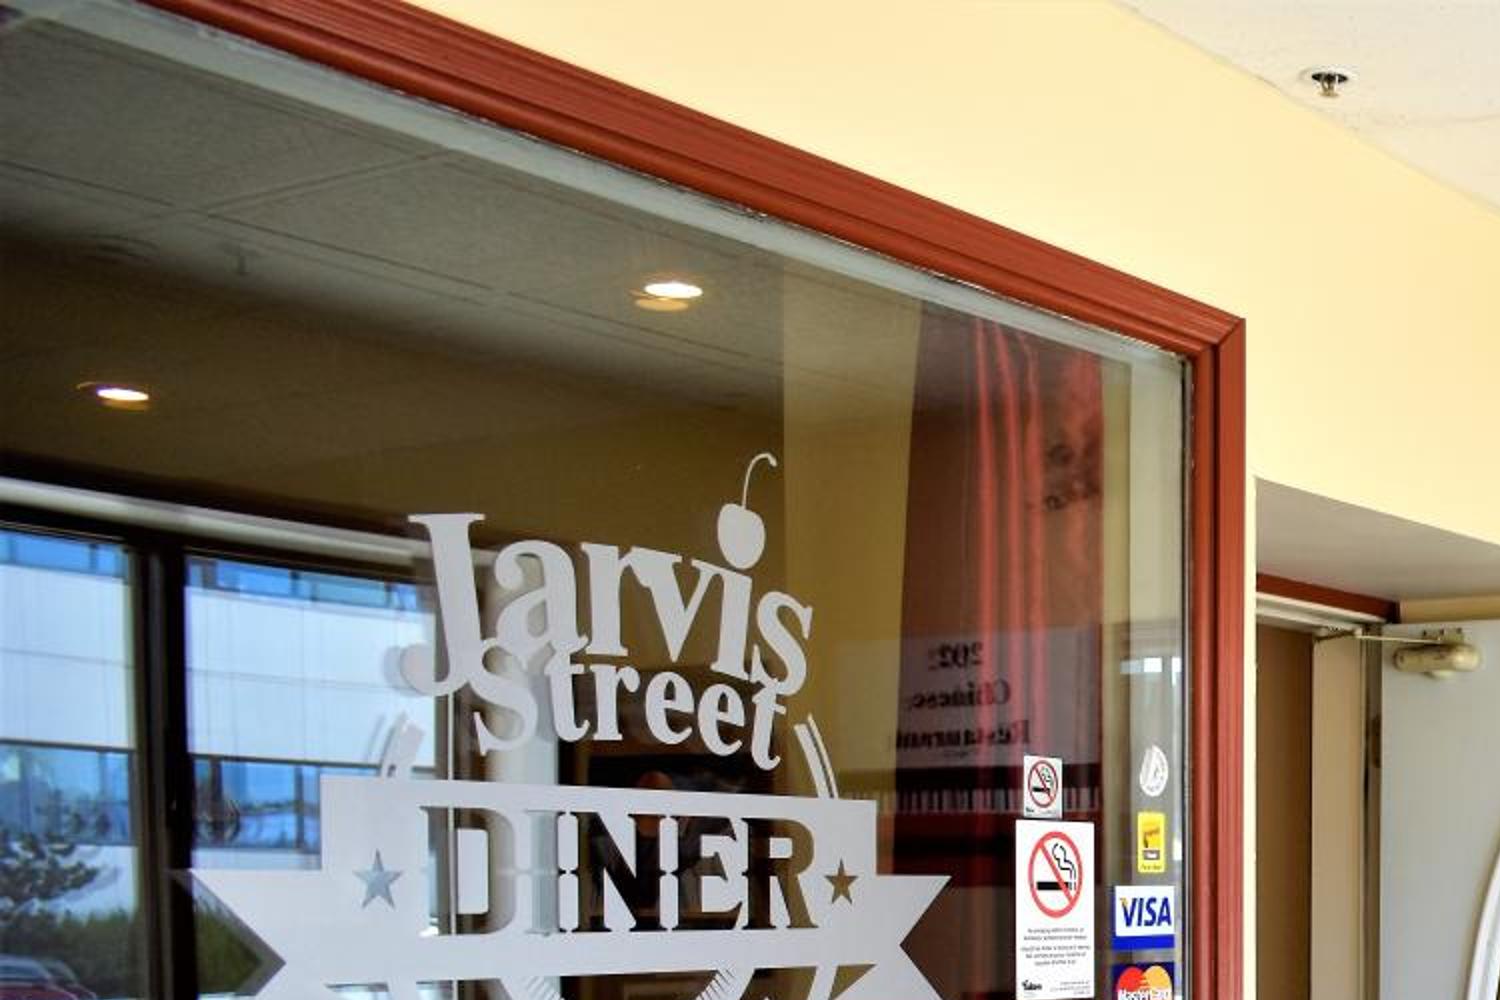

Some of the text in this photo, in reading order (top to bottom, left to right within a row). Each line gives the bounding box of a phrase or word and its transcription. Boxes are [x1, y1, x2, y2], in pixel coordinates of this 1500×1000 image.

[401, 503, 814, 698] Jarvis
[457, 636, 787, 771] Street
[419, 806, 820, 937] DINER
[1120, 896, 1171, 927] VISA
